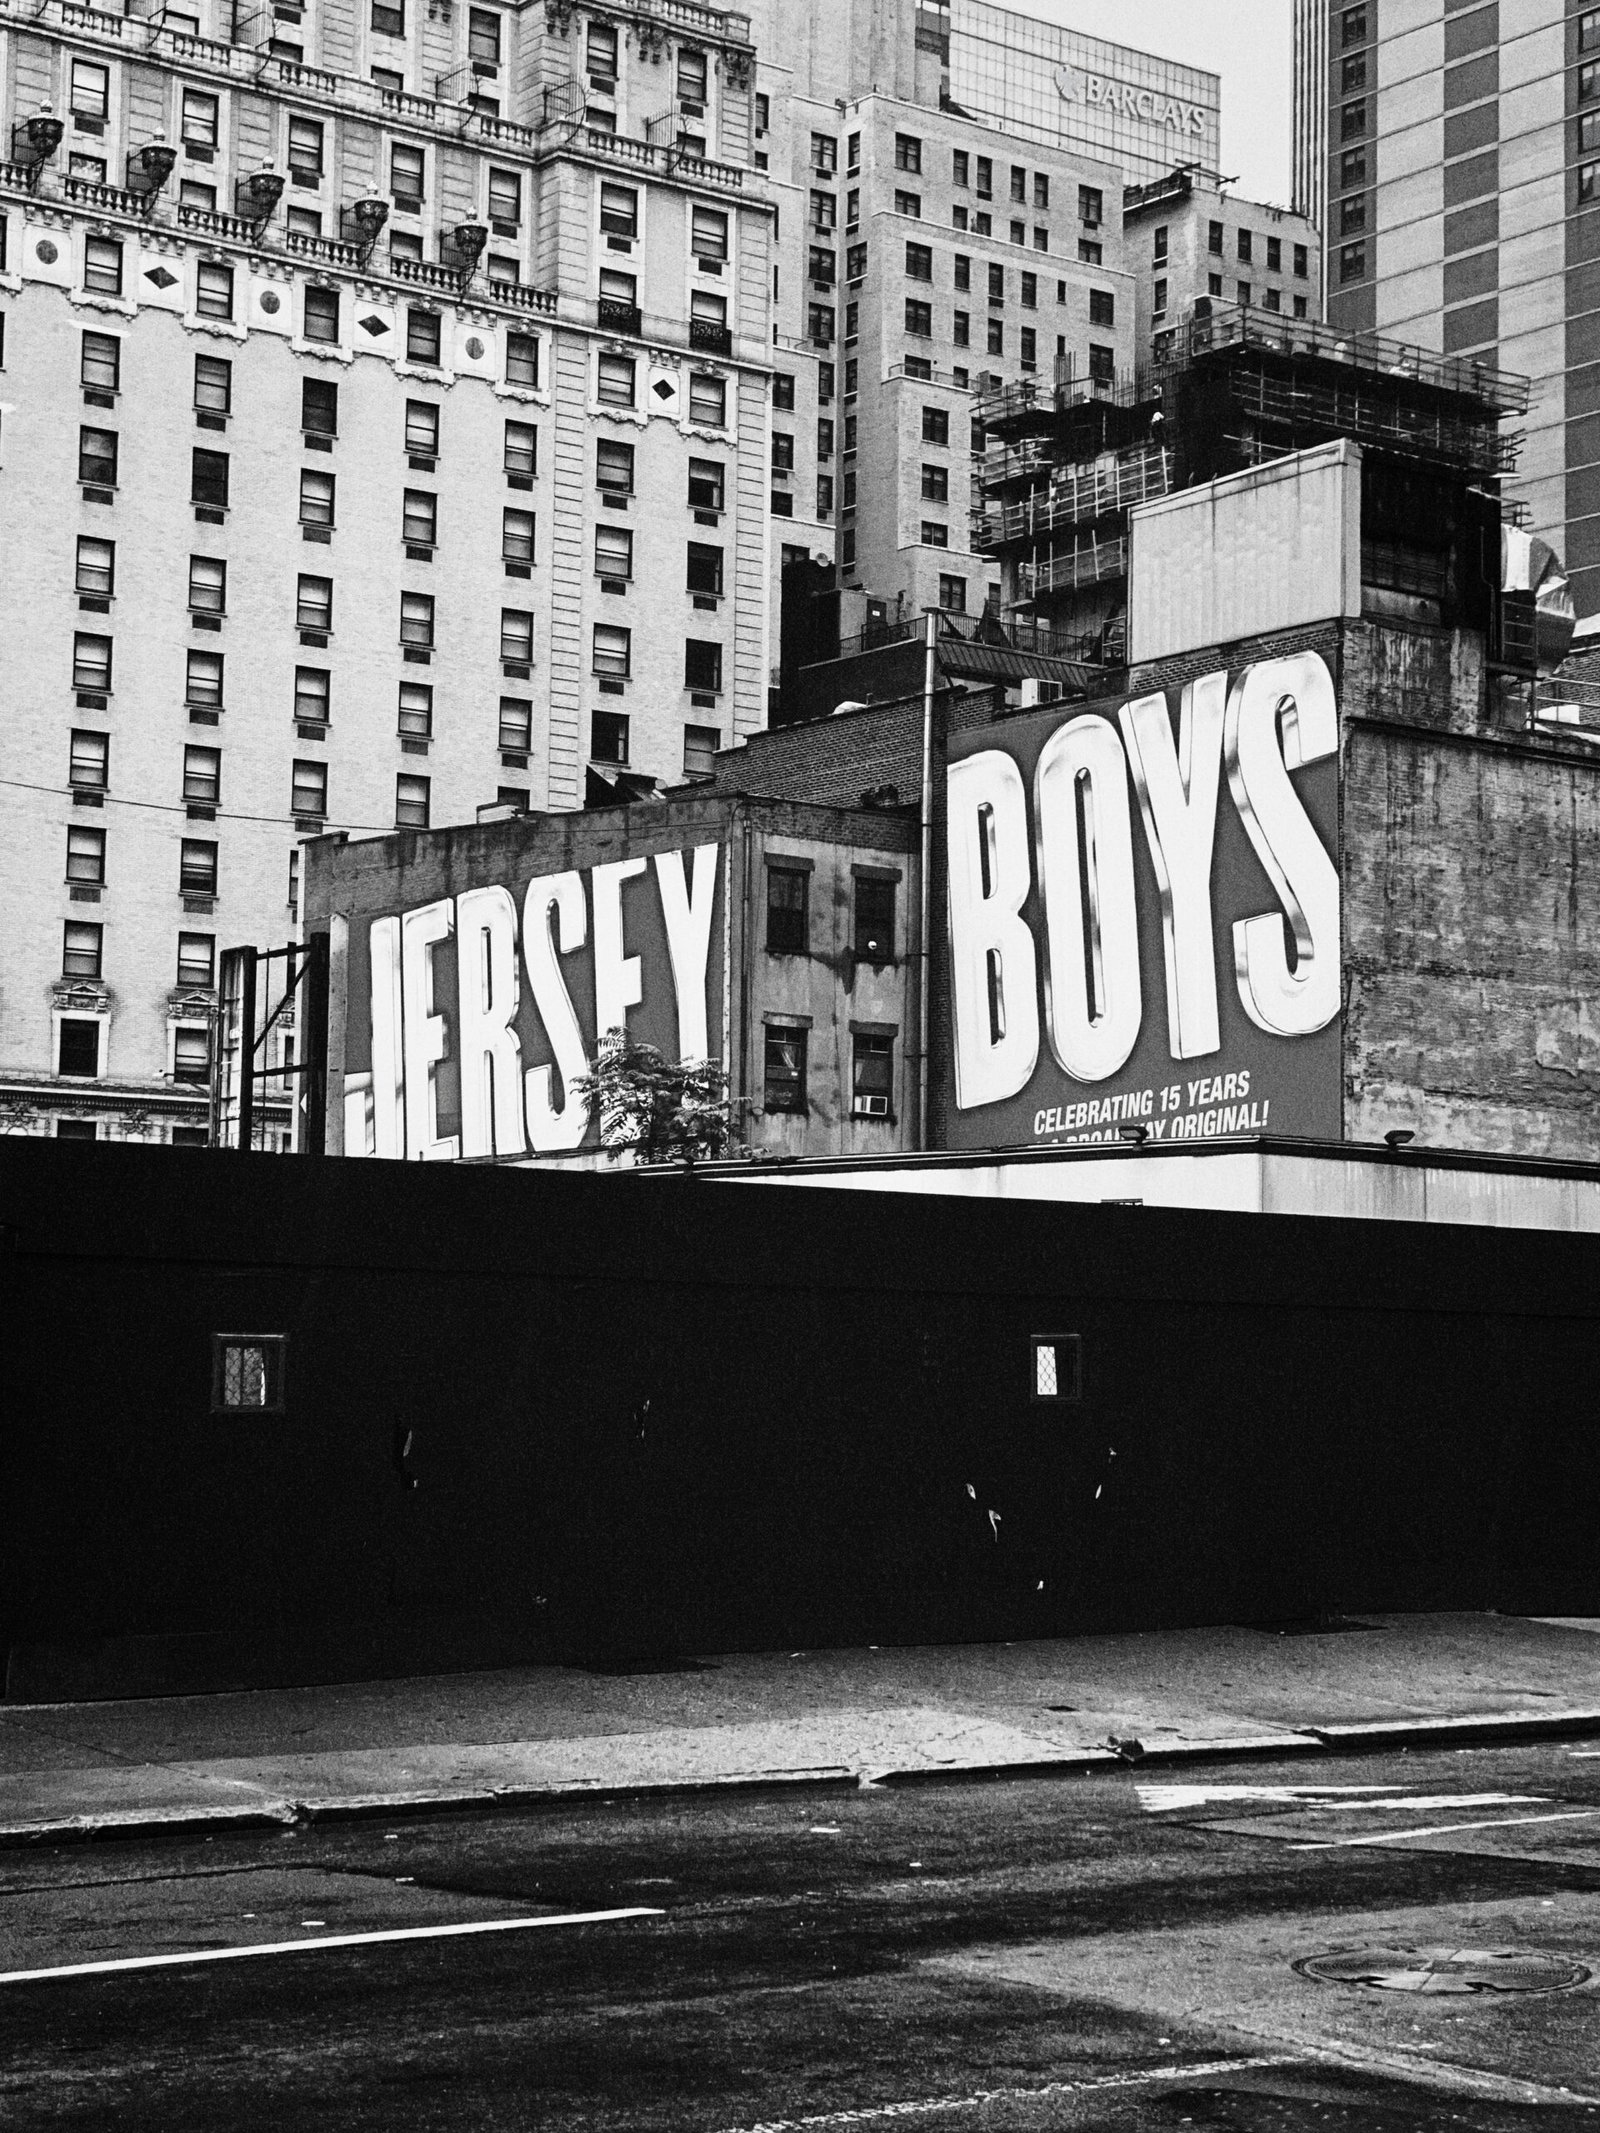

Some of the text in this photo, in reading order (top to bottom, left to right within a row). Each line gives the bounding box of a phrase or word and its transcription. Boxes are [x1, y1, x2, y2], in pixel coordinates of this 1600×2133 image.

[1086, 75, 1205, 134] BARCLAYS
[946, 650, 1341, 1110] BOYS
[344, 842, 718, 1161] JERSEY
[1033, 1070, 1250, 1135] CELEBRATING 15 YEARS
[1170, 1100, 1270, 1138] ORIGINAL!
